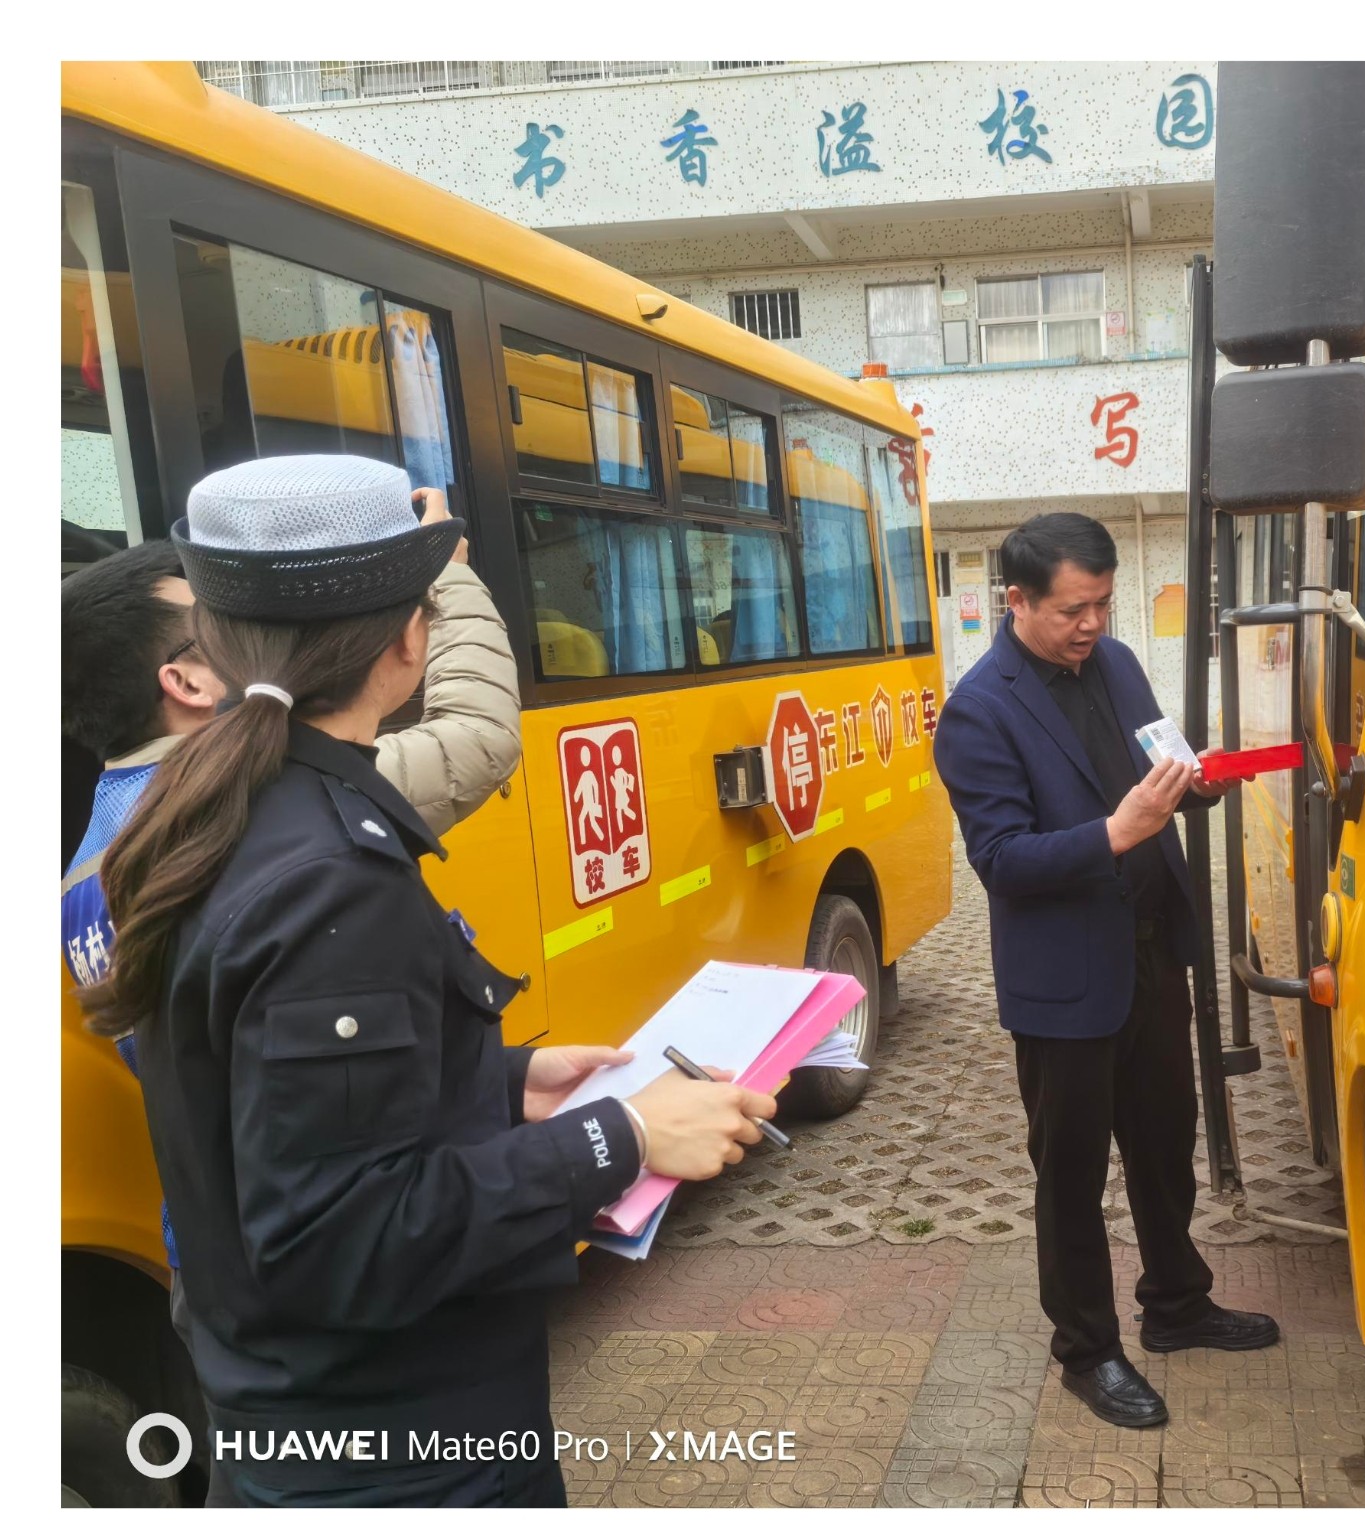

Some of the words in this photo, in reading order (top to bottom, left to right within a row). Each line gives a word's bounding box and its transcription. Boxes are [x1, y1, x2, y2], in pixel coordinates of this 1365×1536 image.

[513, 73, 1215, 198] 书香溢校园
[782, 723, 814, 811] 停
[584, 845, 641, 896] 校车
[583, 1117, 612, 1168] POLICE
